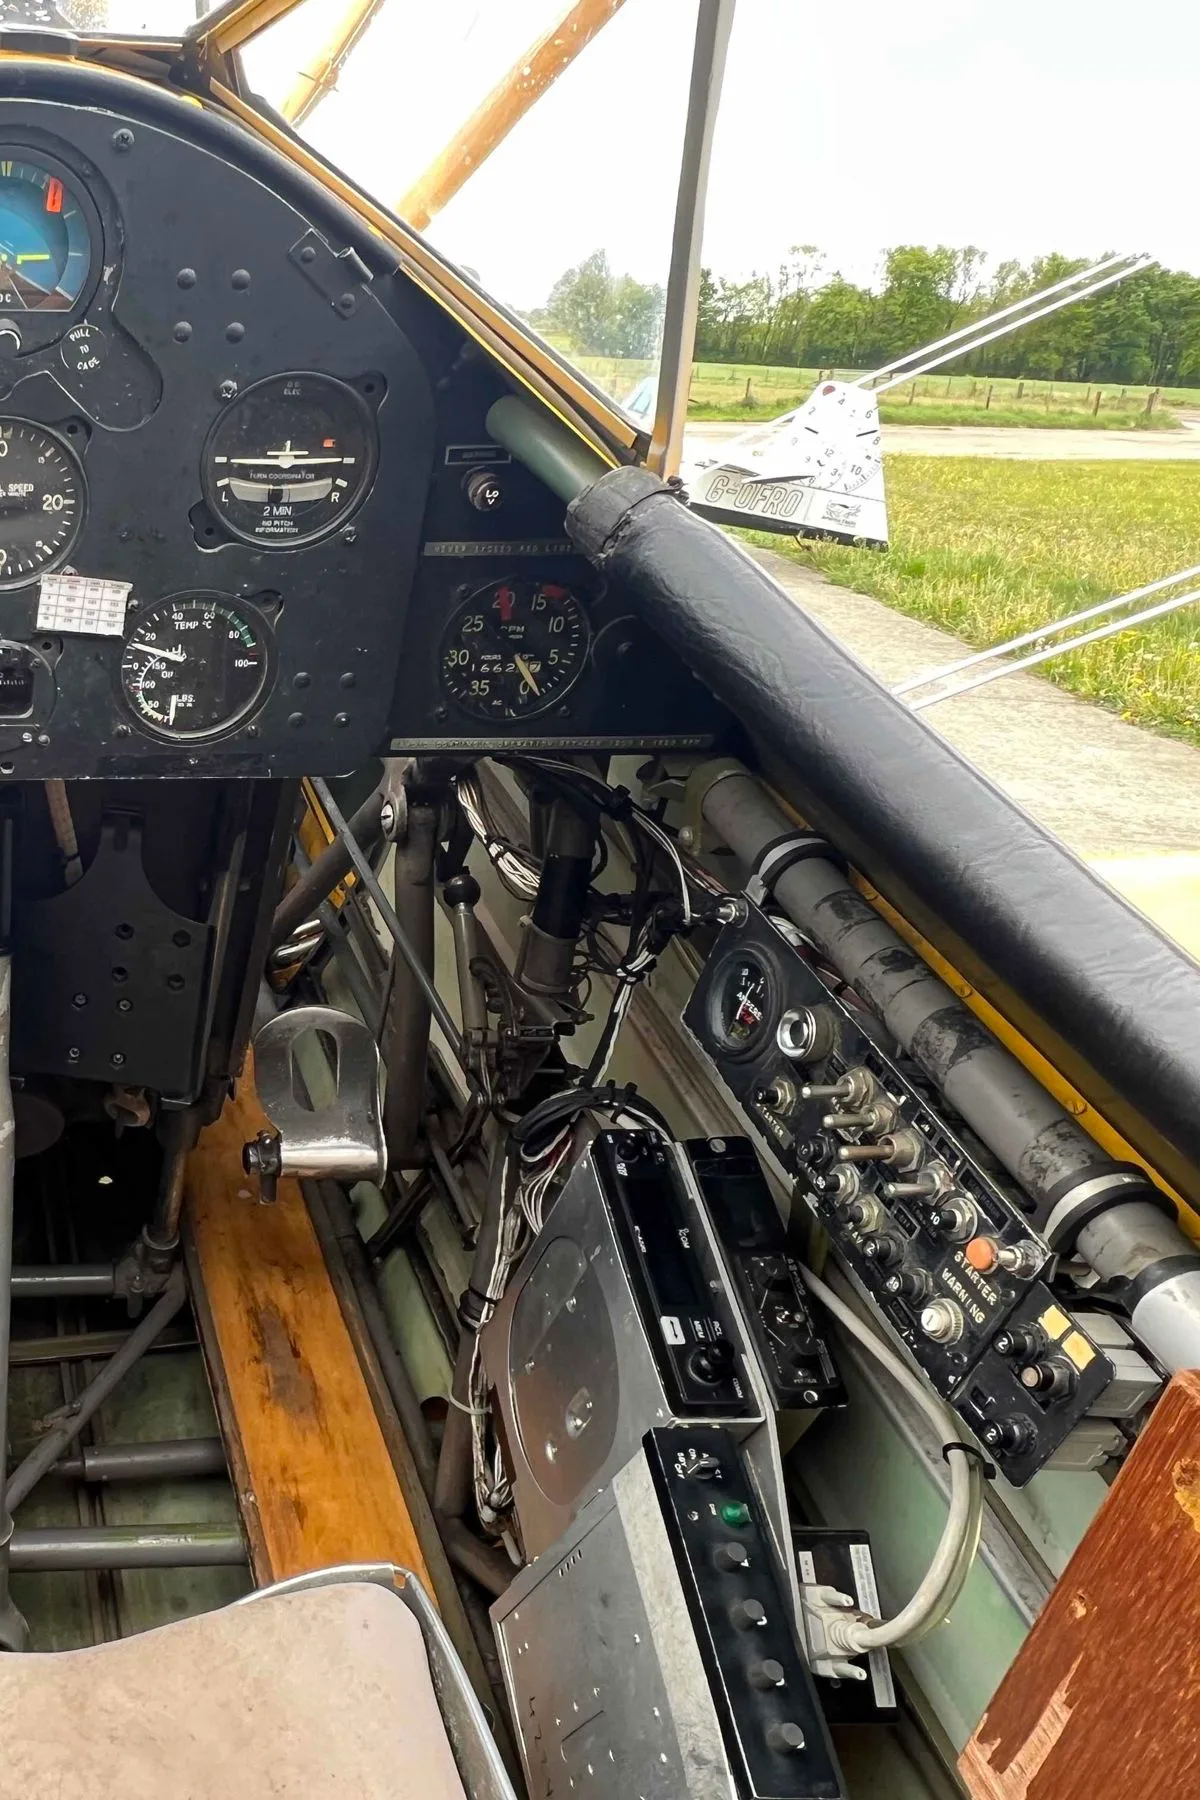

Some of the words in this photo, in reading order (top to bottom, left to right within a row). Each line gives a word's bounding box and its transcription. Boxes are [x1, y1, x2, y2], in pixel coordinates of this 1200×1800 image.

[69, 327, 91, 341] PULL
[77, 358, 100, 371] CAGE
[808, 407, 816, 416] 2
[824, 448, 835, 457] 12
[830, 468, 838, 477] 3
[850, 464, 862, 475] 10
[268, 471, 315, 480] COORDINATOR
[8, 483, 34, 492] SPEED
[222, 492, 229, 502] L
[331, 492, 340, 502] R
[486, 490, 499, 498] LO
[43, 494, 63, 511] 20
[263, 507, 270, 516] 2
[273, 506, 292, 516] MIN
[531, 594, 546, 610] 15
[172, 612, 183, 620] 40
[204, 612, 215, 620] 60
[174, 622, 198, 630] TEMP
[462, 615, 484, 632] 25
[549, 616, 564, 632] 10
[145, 633, 156, 641] 20
[229, 630, 239, 639] 80
[448, 650, 469, 667] 30
[548, 649, 559, 664] 5
[133, 662, 138, 670] 0
[152, 662, 166, 670] 150
[235, 659, 248, 667] 100
[142, 681, 155, 689] 100
[469, 680, 489, 695] 35
[930, 1212, 940, 1226] 10
[866, 1244, 876, 1257] 2
[954, 1250, 998, 1306] STARTER
[941, 1267, 986, 1324] WARNING
[999, 1338, 1009, 1350] 2
[986, 1428, 997, 1440] 2
